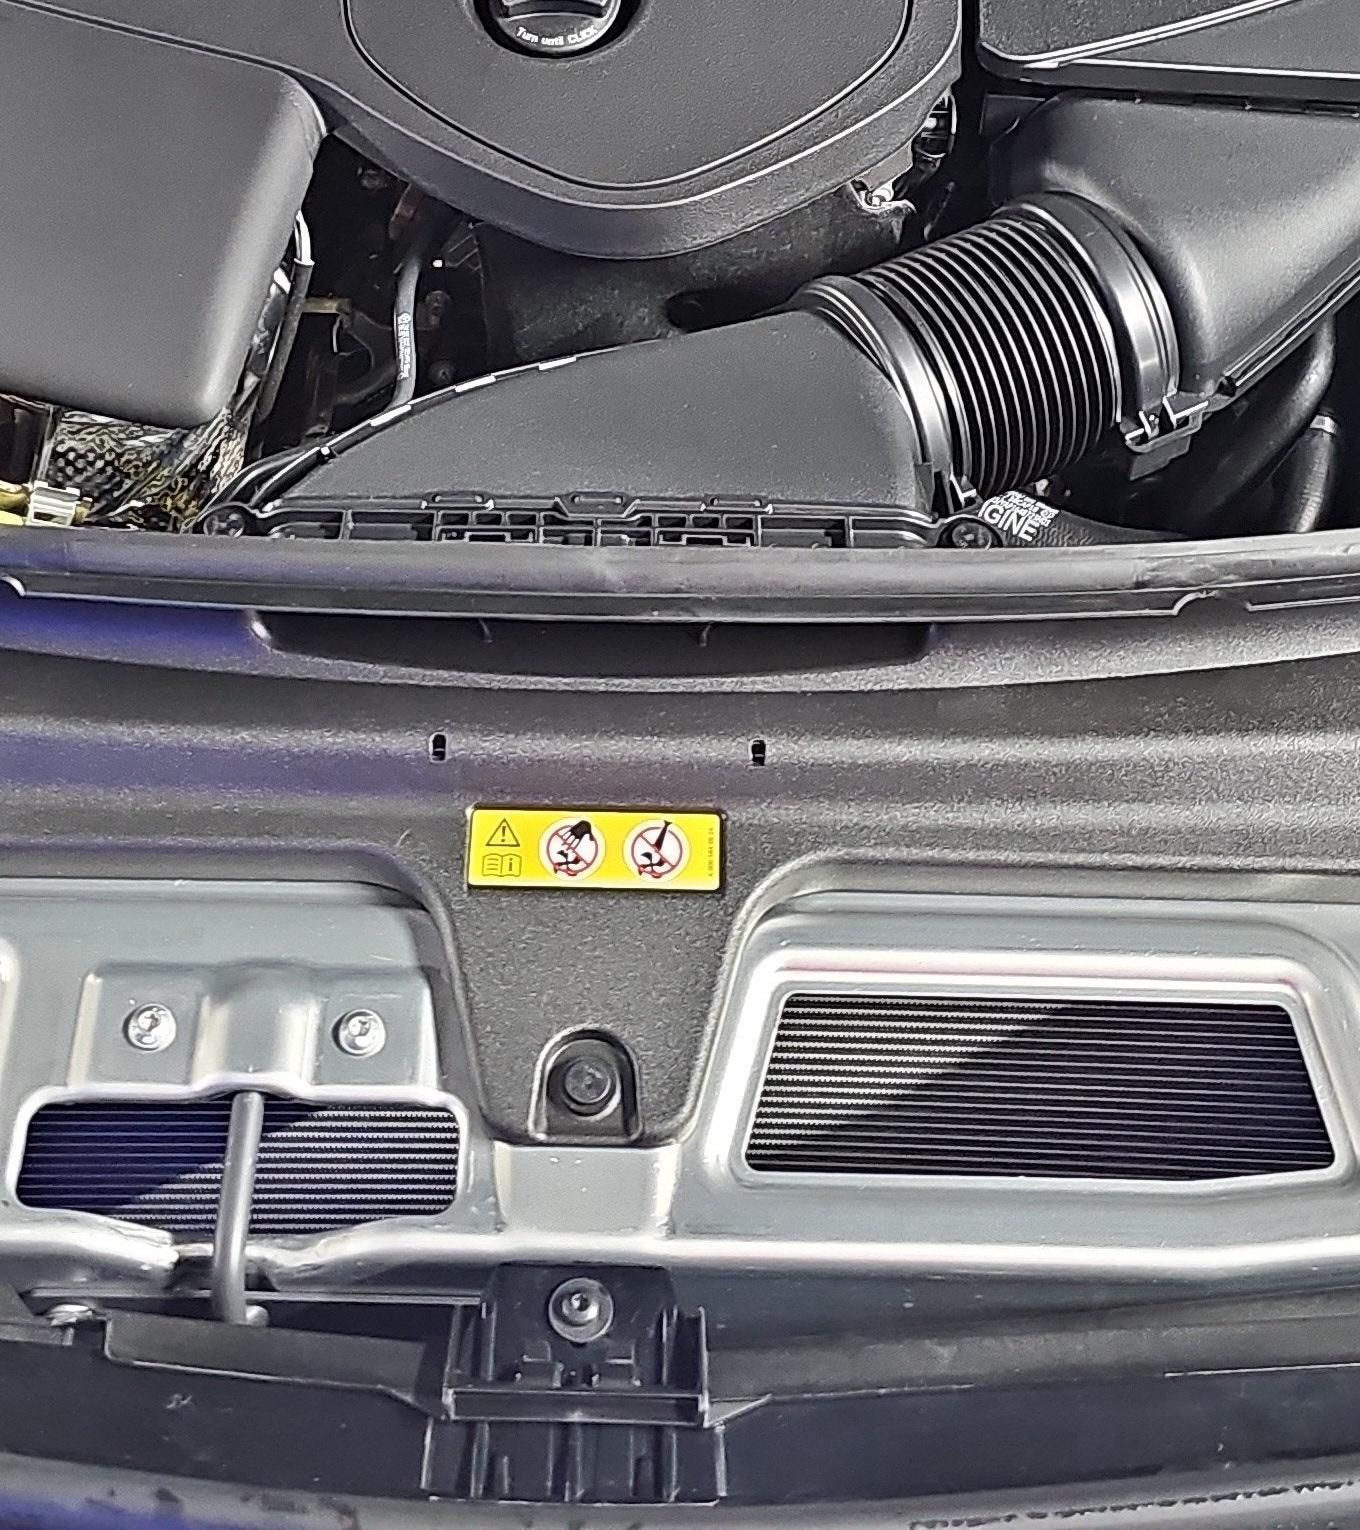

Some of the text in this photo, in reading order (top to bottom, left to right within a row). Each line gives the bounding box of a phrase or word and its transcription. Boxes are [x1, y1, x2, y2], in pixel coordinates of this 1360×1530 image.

[516, 25, 598, 46] Turn until CLICK
